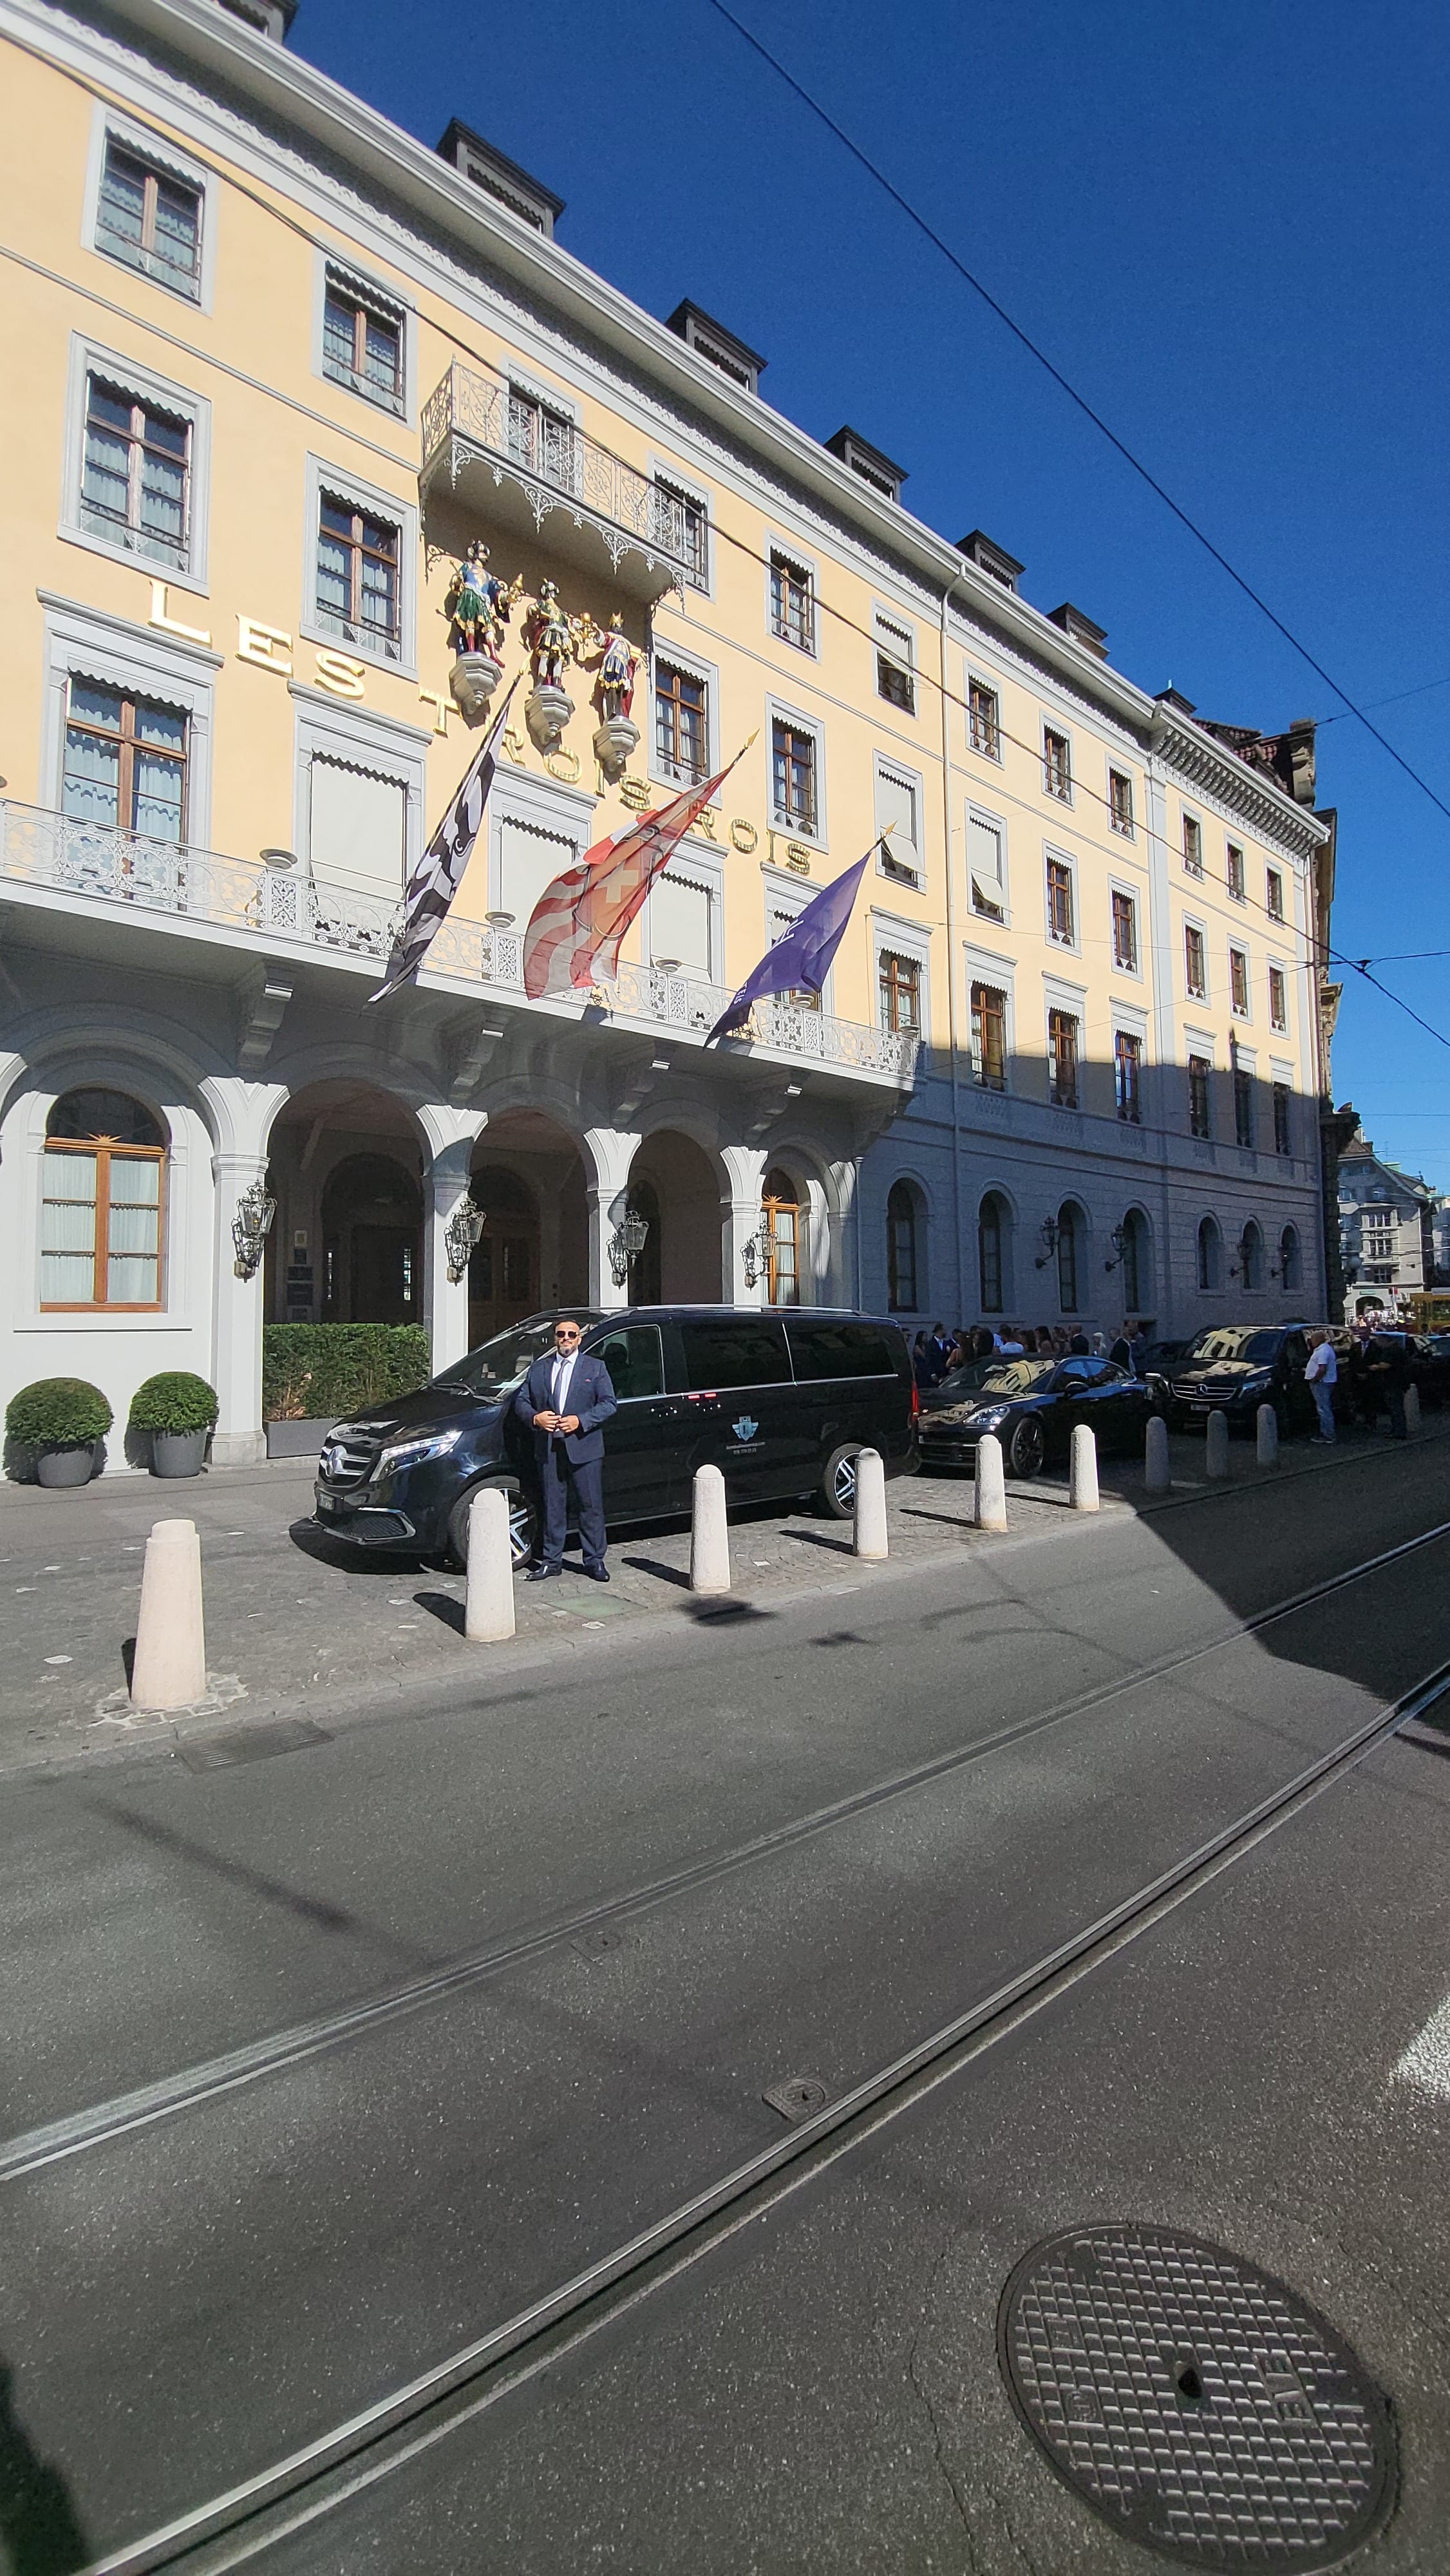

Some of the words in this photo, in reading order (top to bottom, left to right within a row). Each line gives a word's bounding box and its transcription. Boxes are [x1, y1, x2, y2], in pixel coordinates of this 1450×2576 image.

[147, 580, 366, 700] LES
[419, 685, 651, 811] TROIS
[686, 799, 811, 875] ROIS
